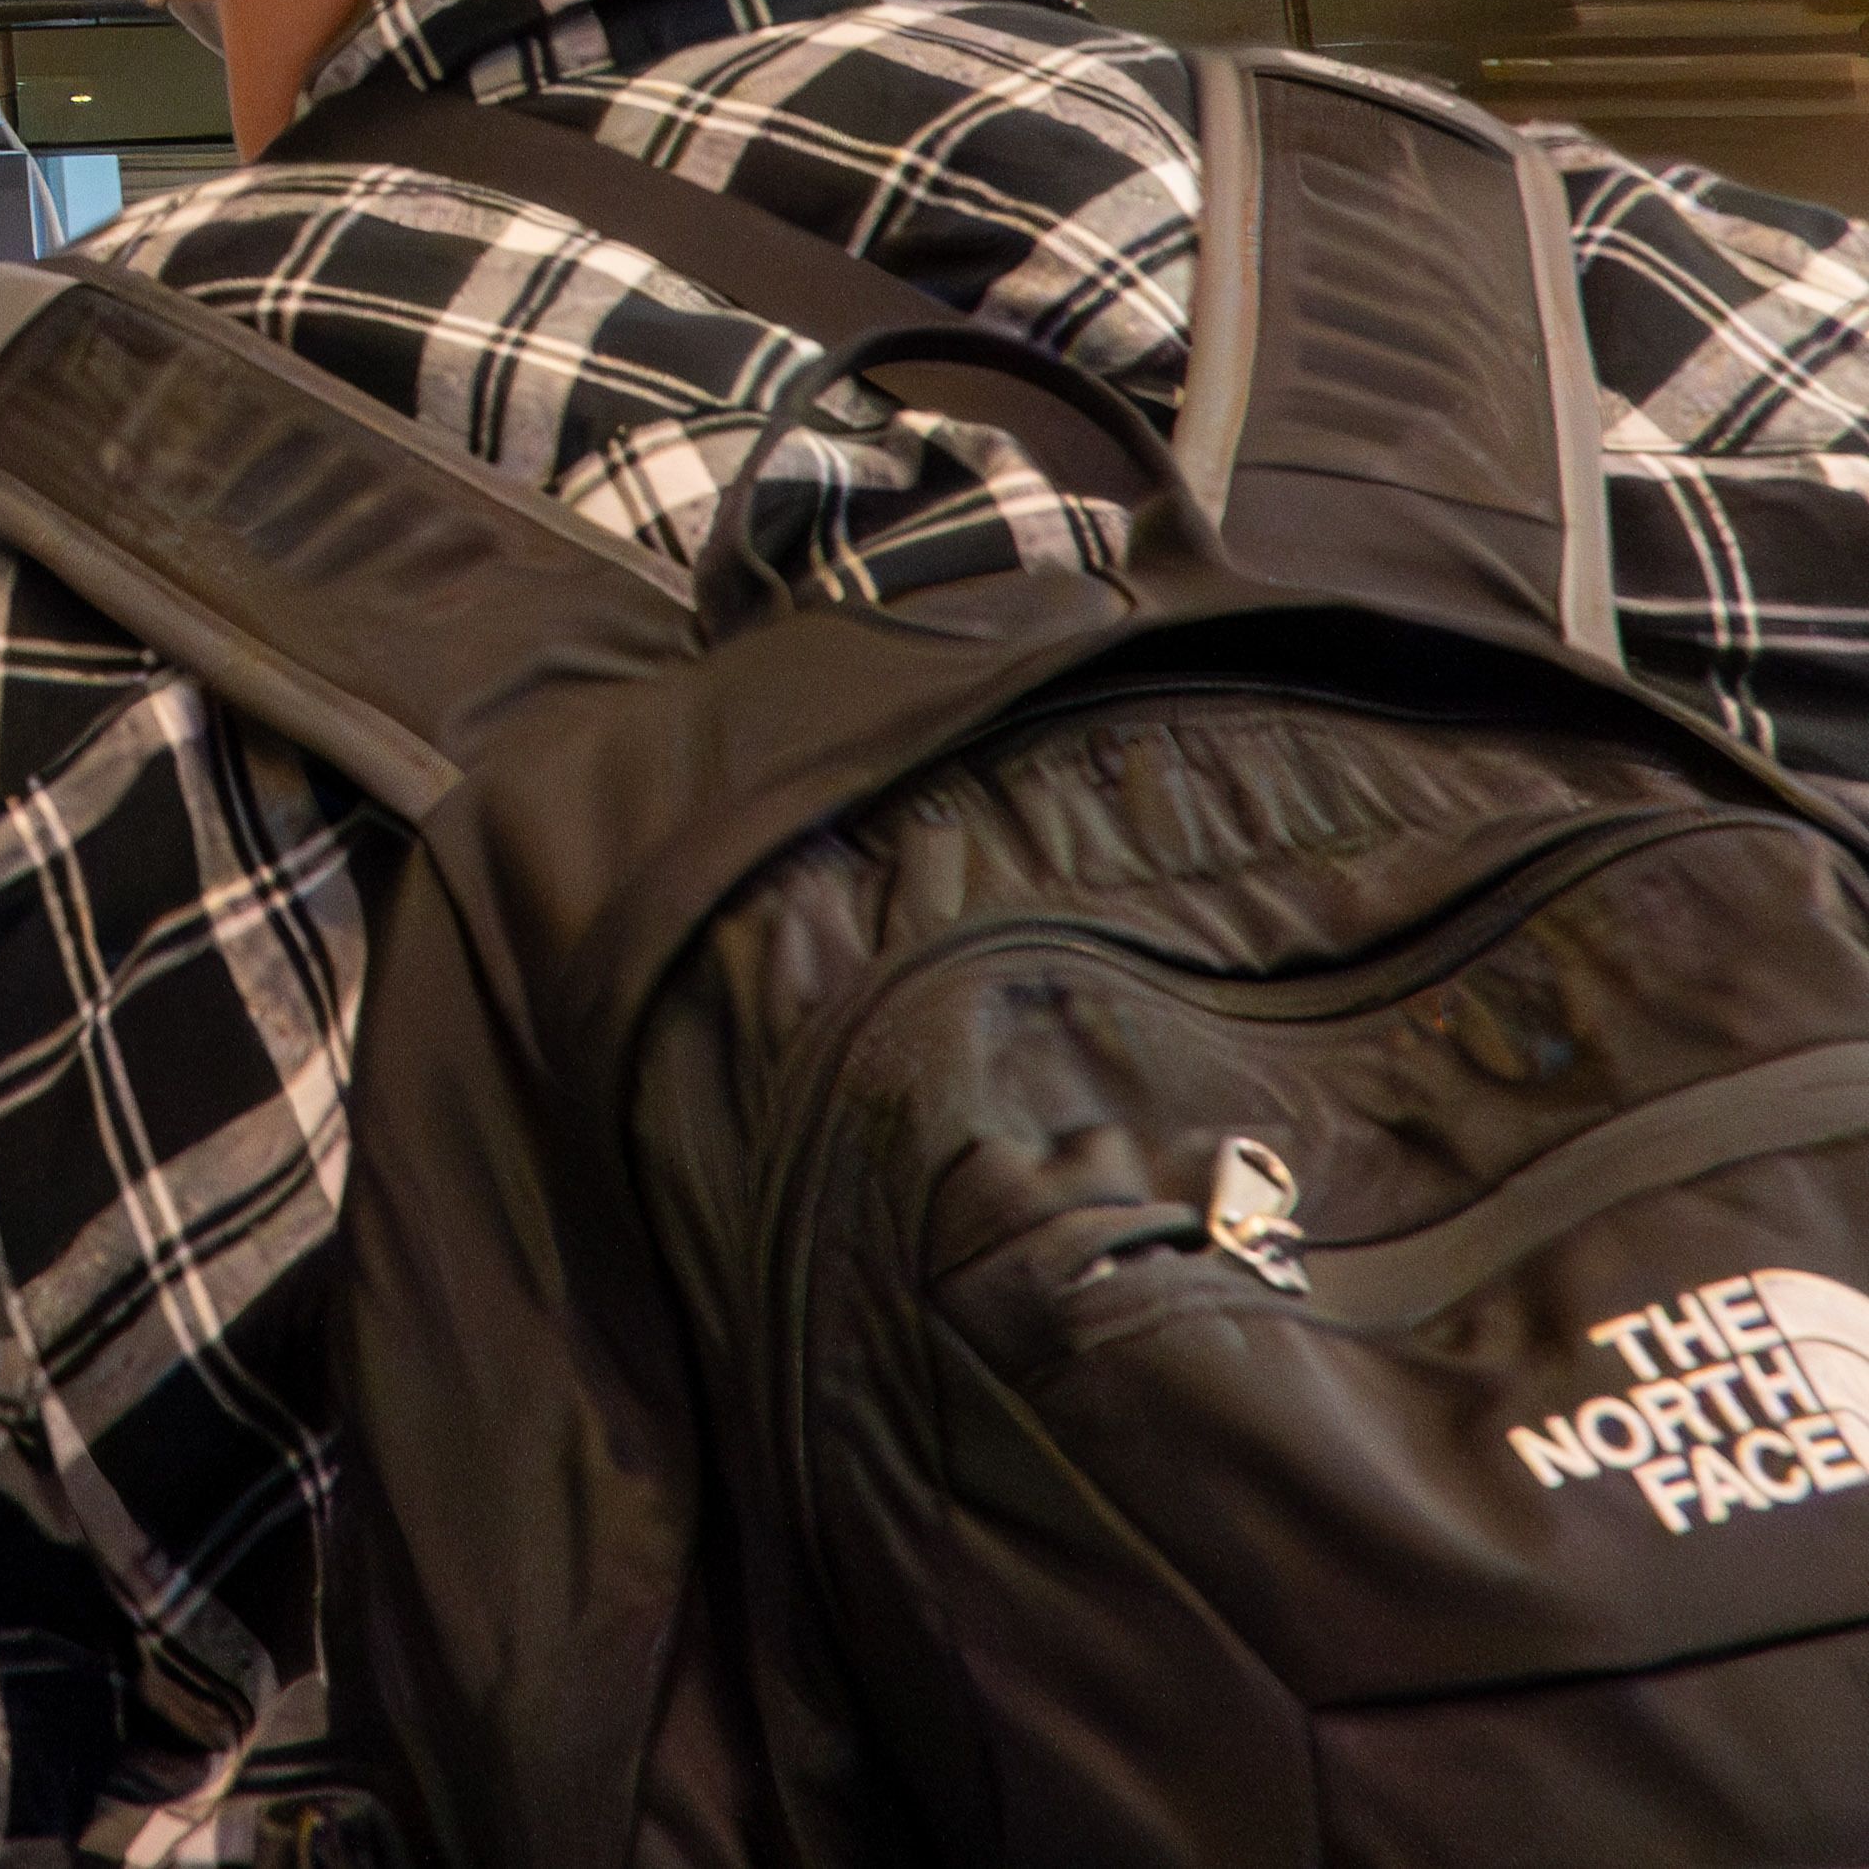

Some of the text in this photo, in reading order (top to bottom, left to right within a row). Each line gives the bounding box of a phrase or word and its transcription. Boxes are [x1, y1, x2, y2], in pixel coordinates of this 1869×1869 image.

[1588, 1275, 1786, 1383] THE
[1506, 1340, 1823, 1490] NORTH
[1631, 1411, 1869, 1534] FACE
